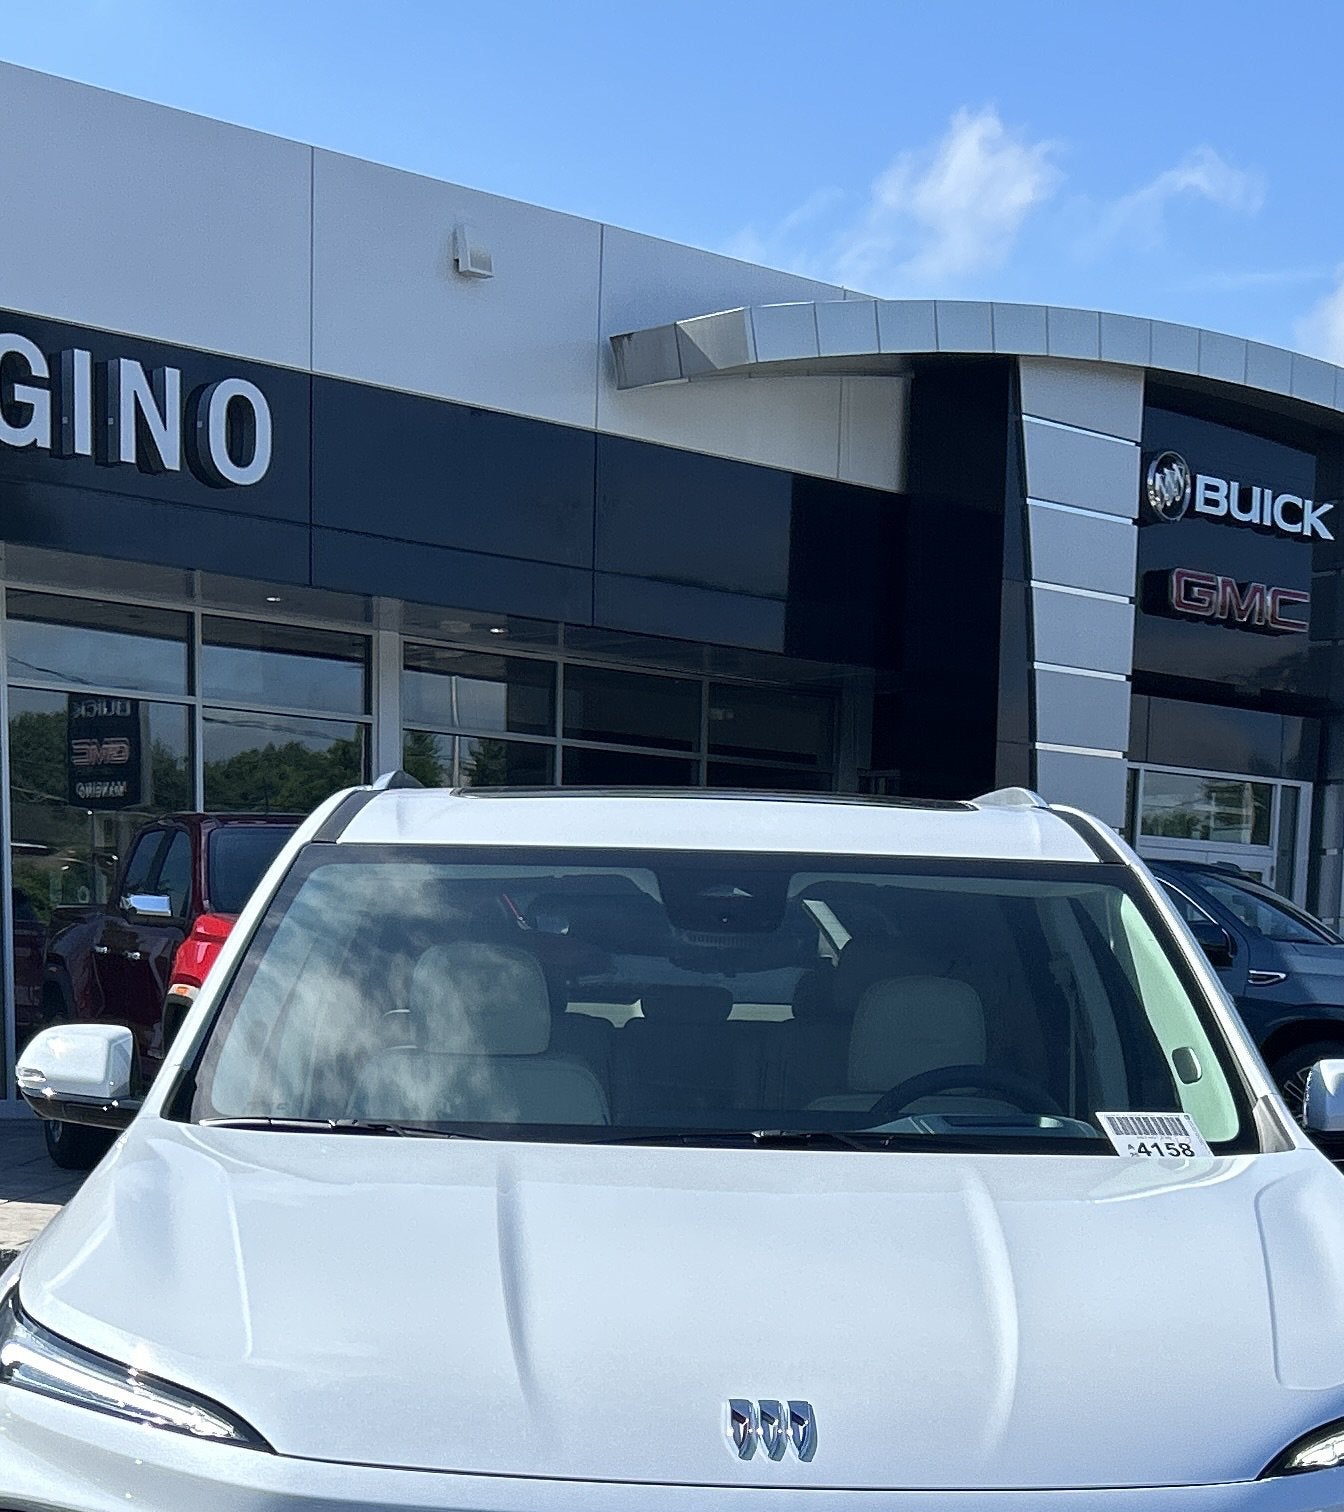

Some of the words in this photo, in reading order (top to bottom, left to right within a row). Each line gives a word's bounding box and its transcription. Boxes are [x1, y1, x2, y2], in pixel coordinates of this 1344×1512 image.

[1194, 474, 1335, 541] BUICK
[1171, 567, 1310, 633] GMC
[1138, 1142, 1195, 1157] 4158
